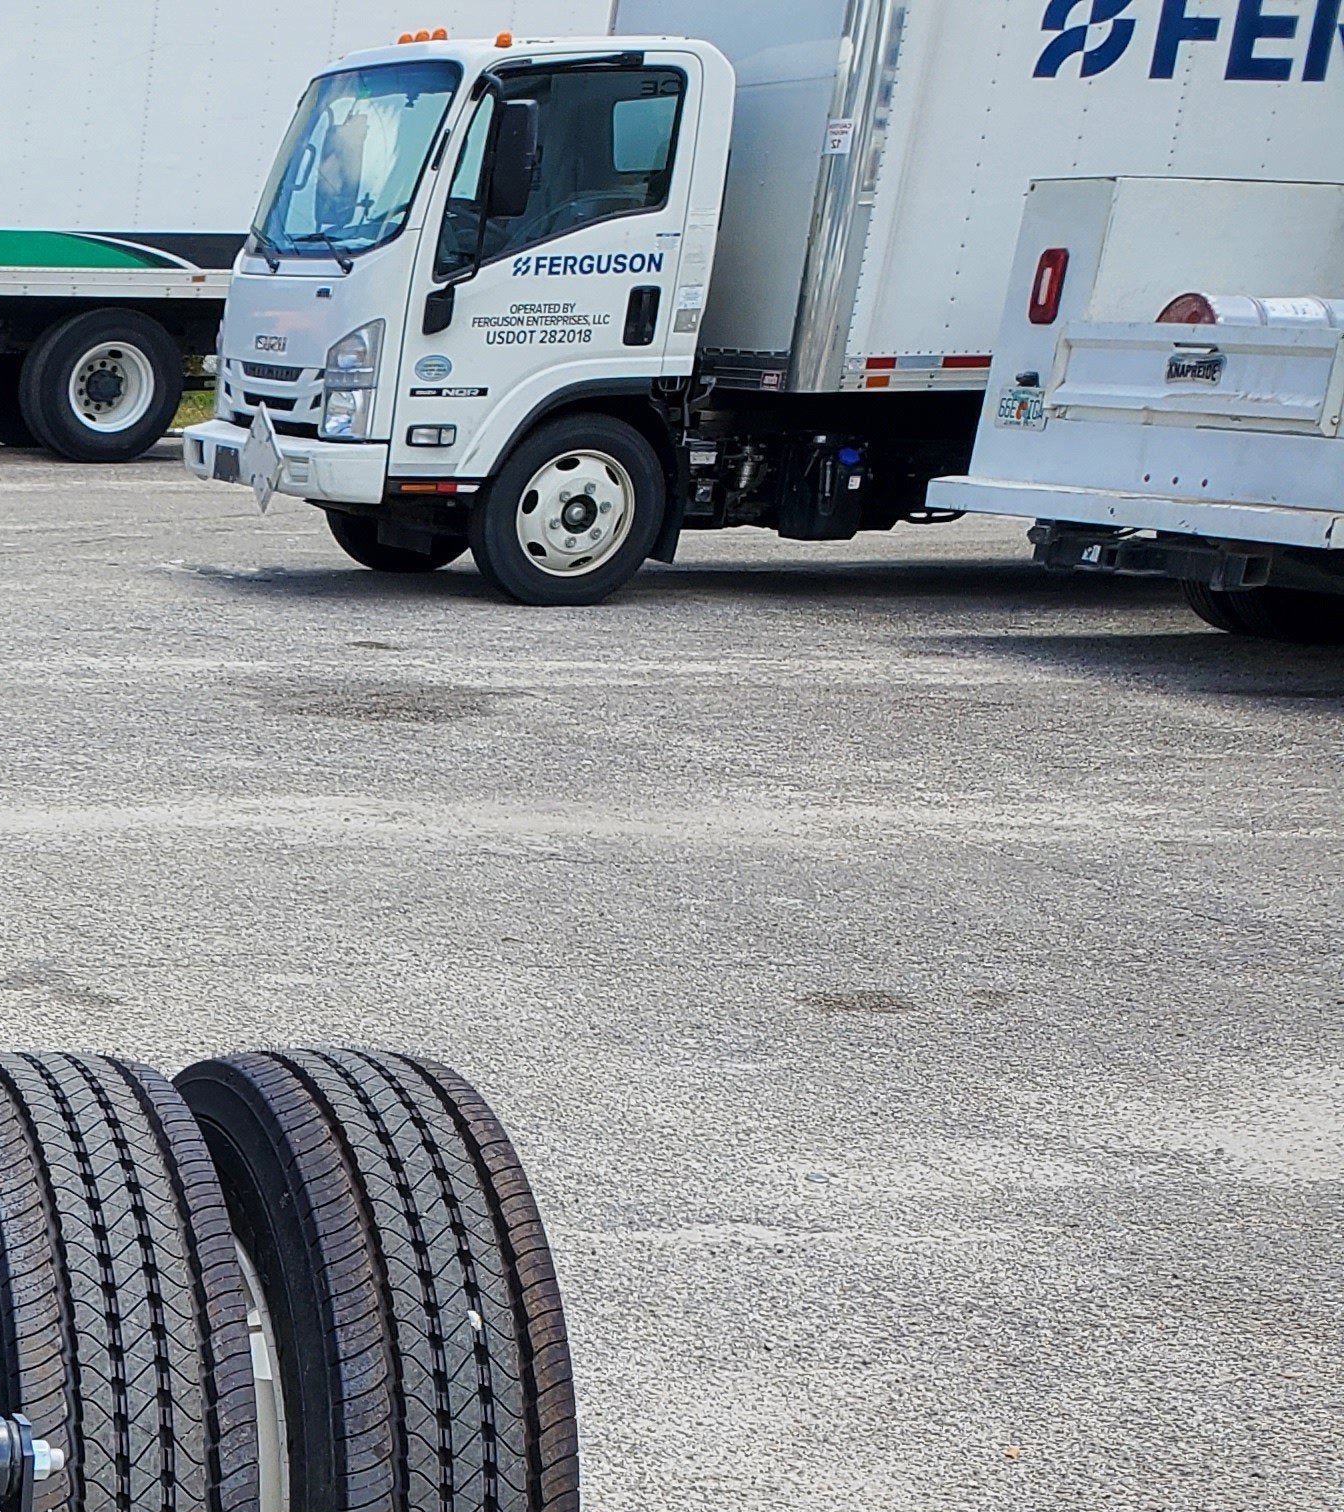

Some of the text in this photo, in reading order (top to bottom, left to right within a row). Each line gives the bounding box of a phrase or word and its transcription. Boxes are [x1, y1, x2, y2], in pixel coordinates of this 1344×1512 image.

[534, 252, 664, 276] FERGUSON
[509, 303, 576, 315] OPERATED BY
[471, 314, 610, 328] FERGUSON ENTERPRISES, LLC
[486, 329, 592, 345] USDOT 282018
